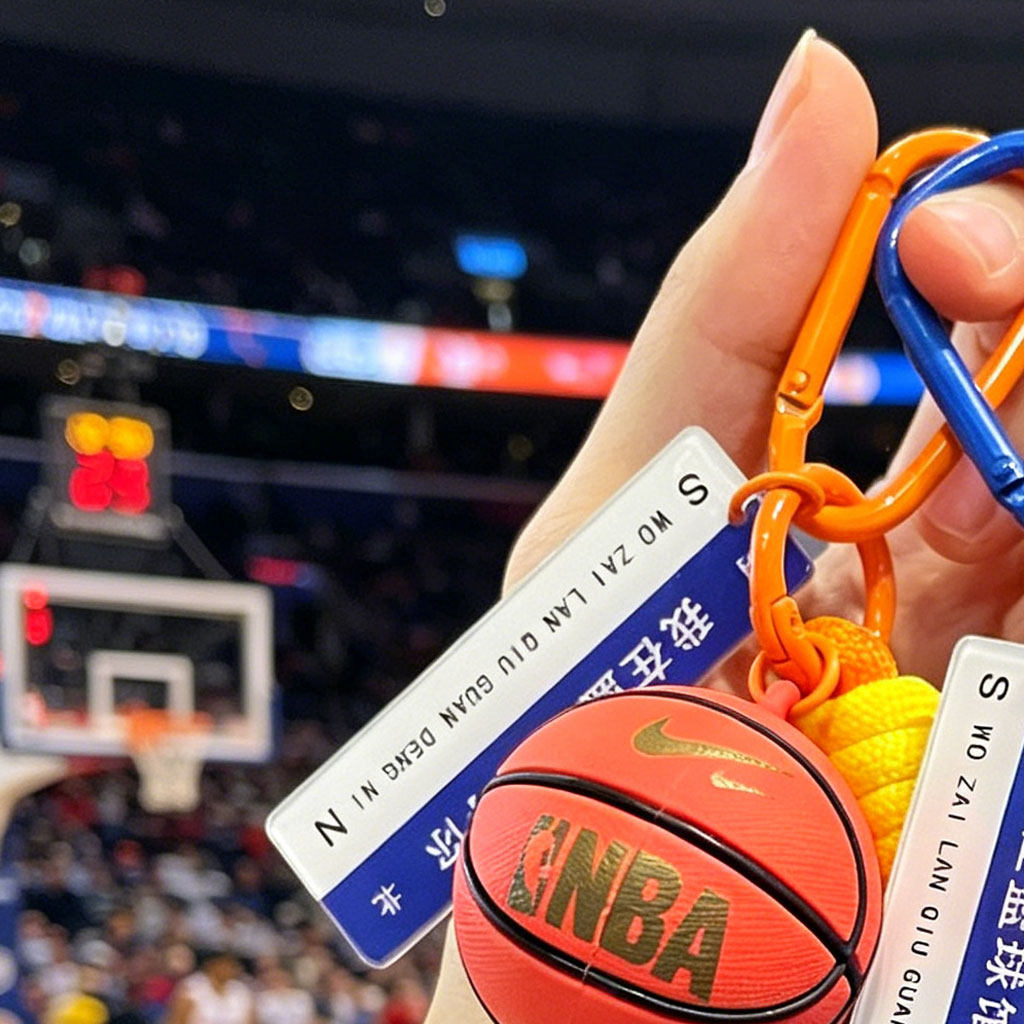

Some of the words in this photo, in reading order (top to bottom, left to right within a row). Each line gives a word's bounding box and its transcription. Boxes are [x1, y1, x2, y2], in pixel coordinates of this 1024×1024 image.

[678, 473, 709, 506] S
[637, 510, 673, 546] WO
[591, 544, 635, 587] ZAI
[542, 587, 588, 633] LAN
[438, 674, 494, 728] GUAN
[979, 672, 1010, 702] S
[382, 726, 436, 780] DENG
[966, 724, 994, 760] WO
[351, 780, 380, 810] NI
[947, 775, 978, 821] ZAI
[314, 808, 348, 847] N
[928, 839, 959, 892] LAN
[370, 882, 402, 917] 北
[545, 827, 730, 1005] NBA
